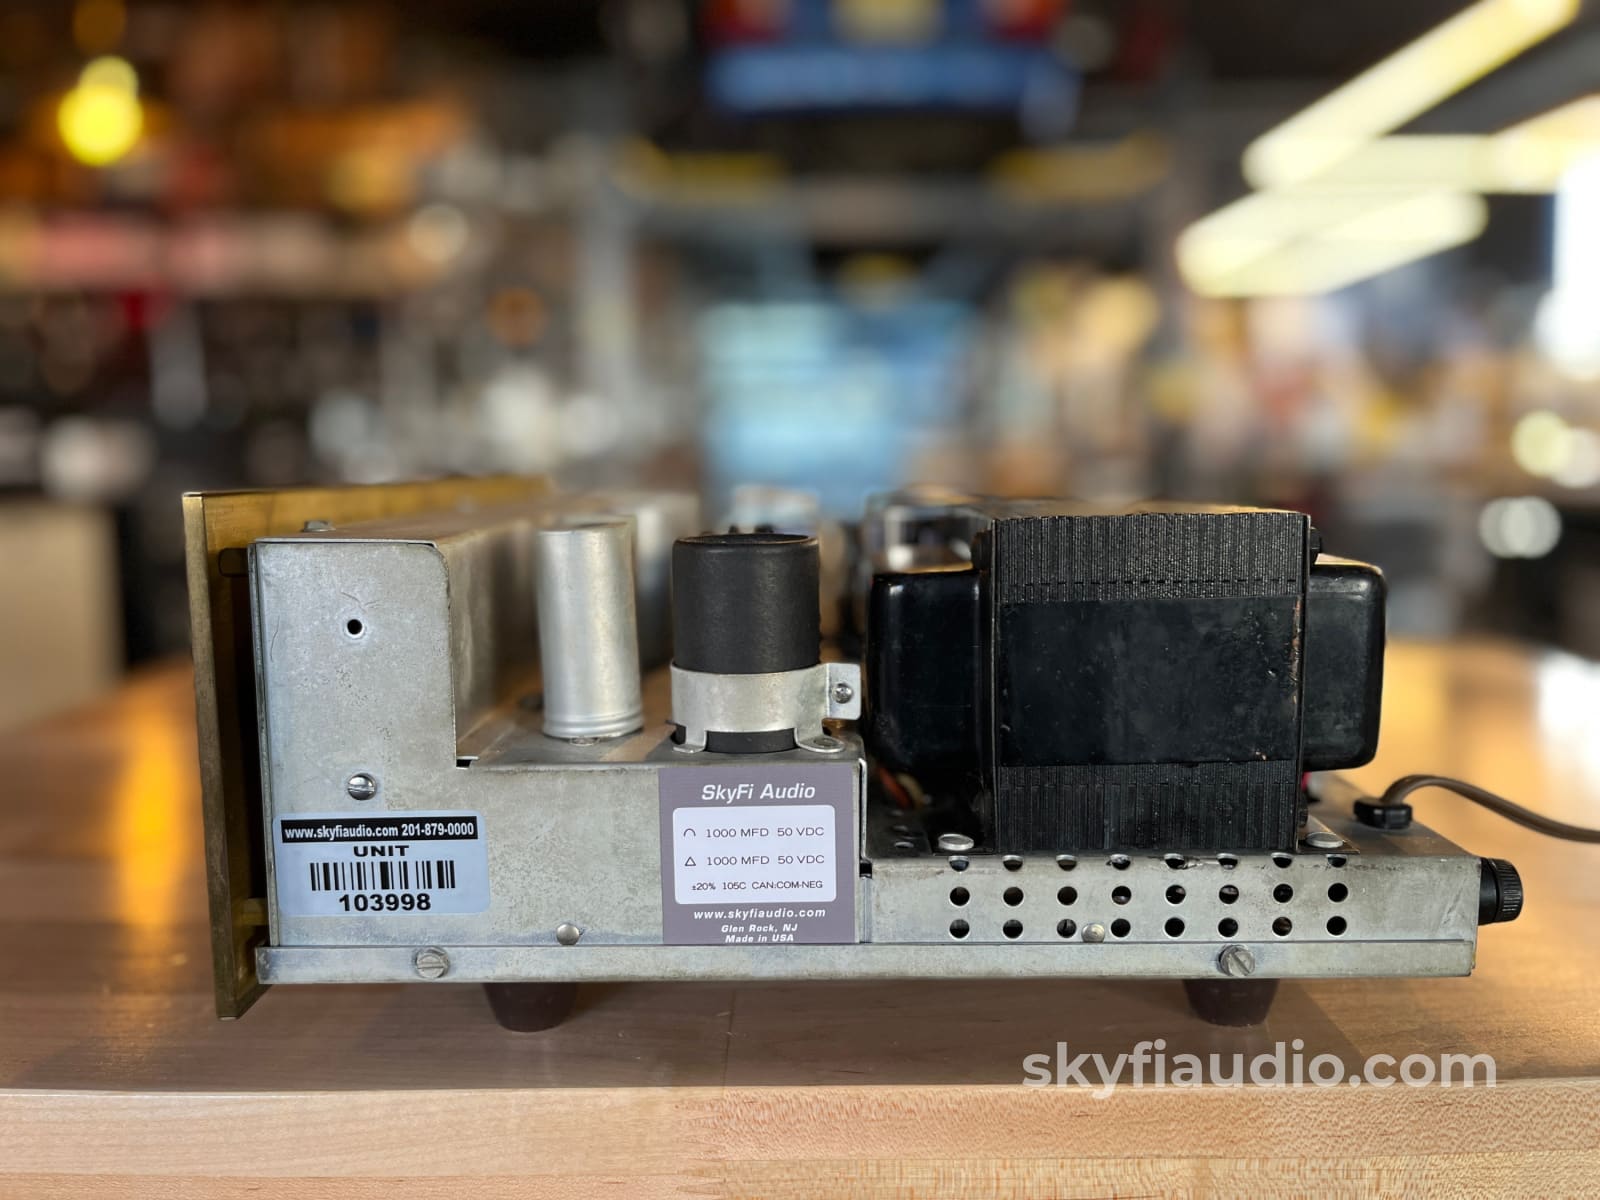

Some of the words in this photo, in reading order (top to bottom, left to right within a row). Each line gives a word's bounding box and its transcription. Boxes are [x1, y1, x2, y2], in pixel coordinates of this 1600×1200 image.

[701, 784, 754, 804] SkyFi
[760, 783, 816, 799] Audio
[285, 825, 398, 841] www.skyfiaudio.com
[401, 822, 474, 837] 201-879-0000
[706, 828, 737, 838] 1000
[740, 828, 769, 837] MFD
[777, 827, 793, 837] 50
[796, 827, 825, 836] VDC
[353, 845, 410, 857] UNIT
[706, 856, 737, 866] 1000
[741, 856, 770, 865] MFD
[778, 855, 793, 865] 50
[797, 855, 825, 864] VDC
[722, 881, 747, 890] 105C
[751, 880, 823, 890] CAN:COM-NEG
[339, 893, 431, 911] 103998
[693, 908, 826, 921] www.skyfiaudio.com
[721, 924, 745, 933] Glen
[749, 924, 778, 933] Rock,
[782, 923, 798, 932] NJ
[725, 935, 754, 943] Made
[757, 934, 768, 942] in
[771, 934, 794, 942] USA
